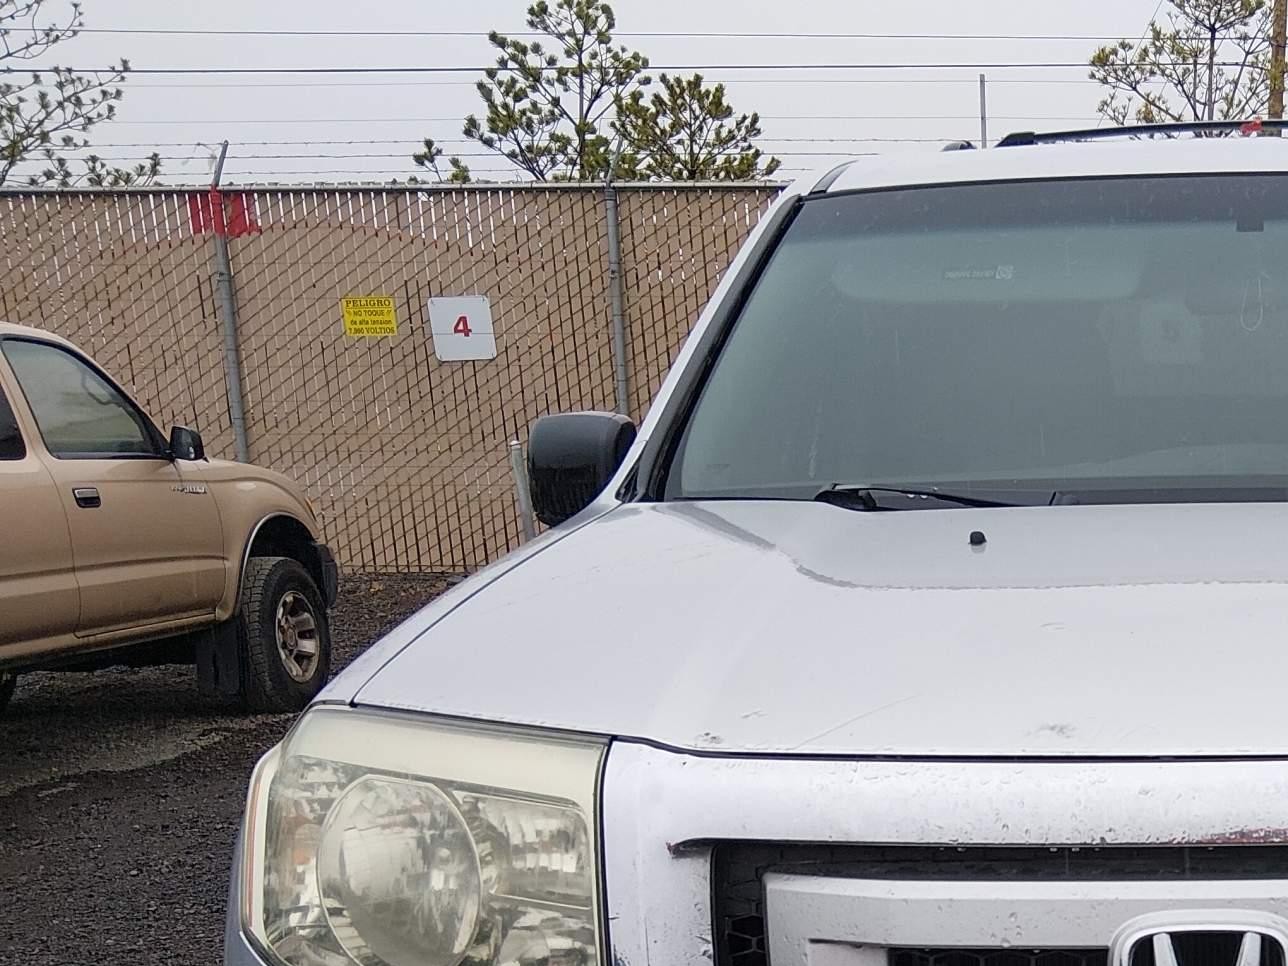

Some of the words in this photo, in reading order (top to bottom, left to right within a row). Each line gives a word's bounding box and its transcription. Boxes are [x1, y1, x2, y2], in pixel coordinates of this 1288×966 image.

[345, 299, 391, 307] PELIGRO
[364, 309, 385, 317] TOQUE
[365, 326, 395, 334] VOLTIOS
[453, 315, 473, 337] 4
